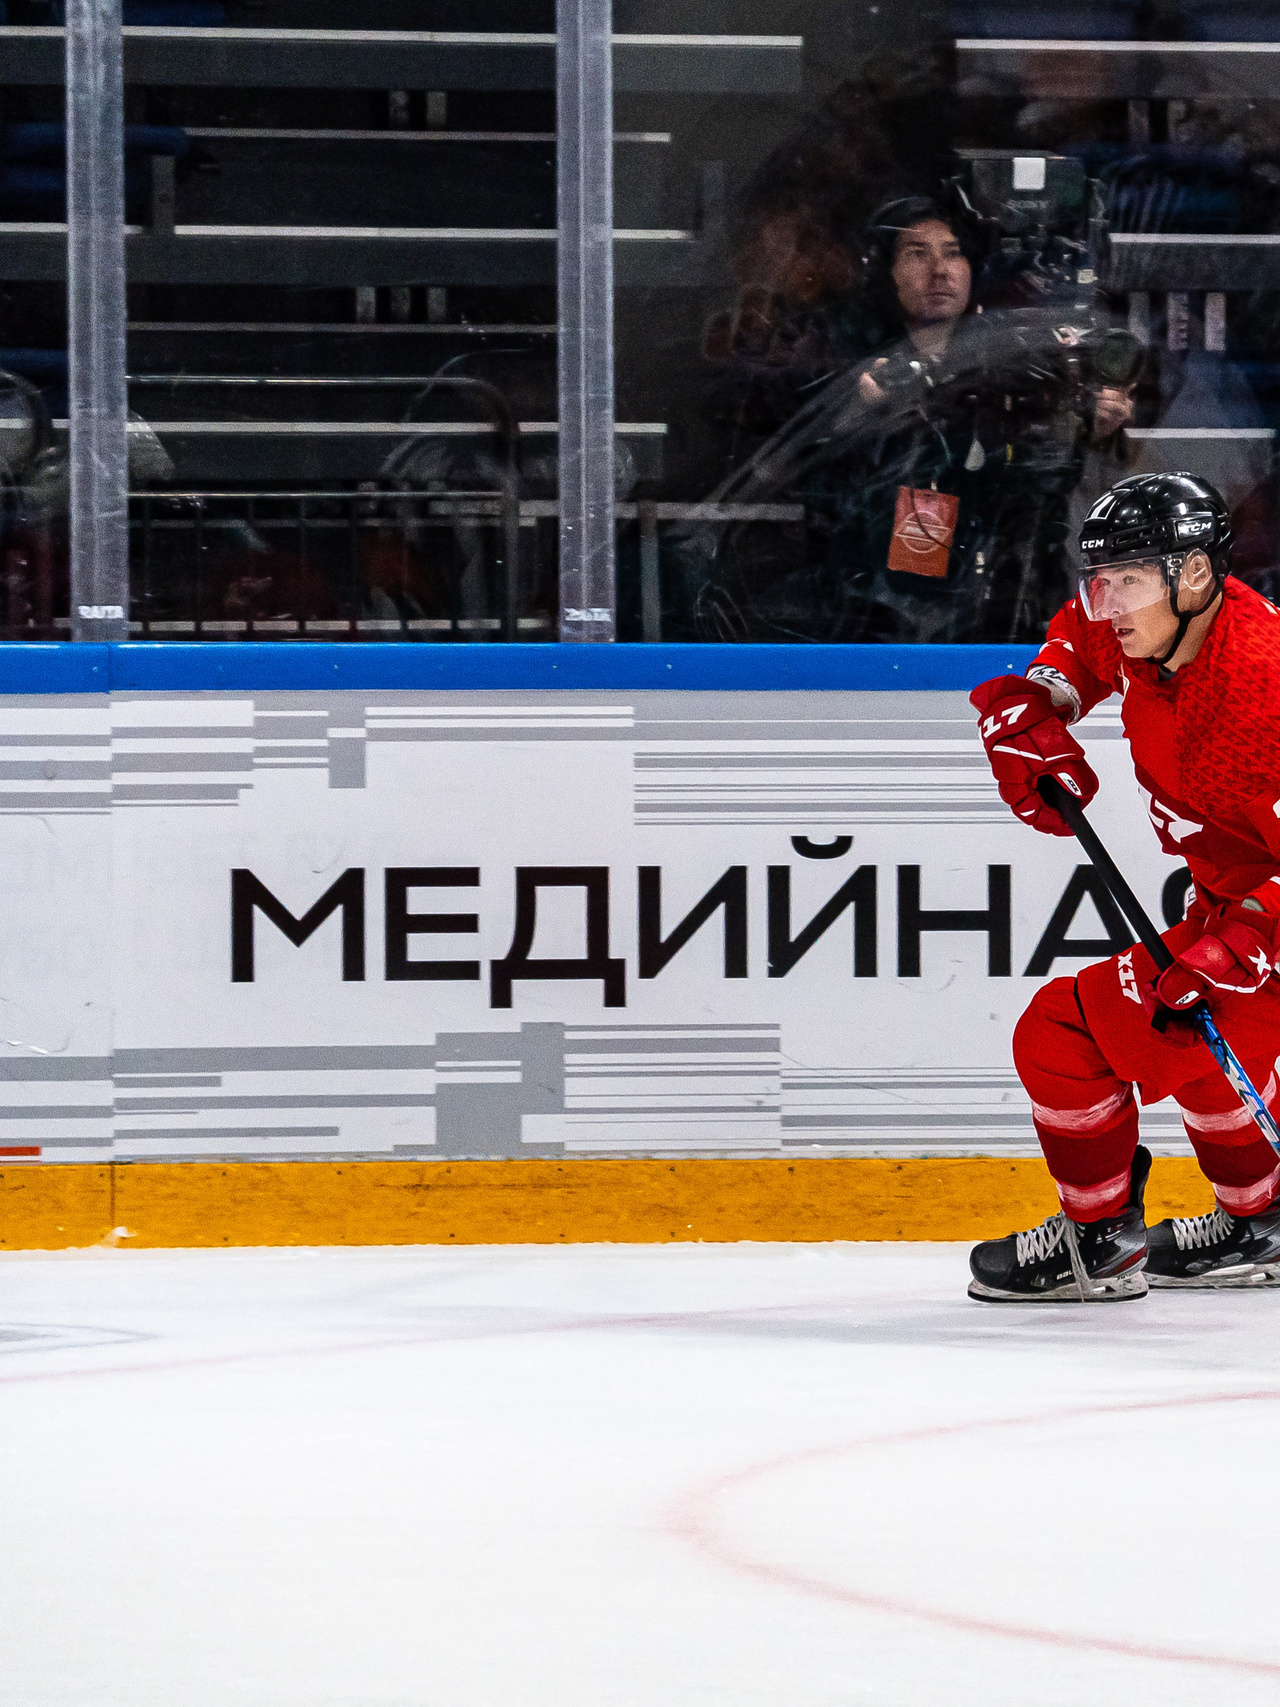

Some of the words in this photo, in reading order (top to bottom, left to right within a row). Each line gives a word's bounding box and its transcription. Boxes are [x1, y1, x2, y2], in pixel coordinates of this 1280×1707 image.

[1081, 538, 1105, 549] CCM
[982, 703, 1028, 739] 17
[230, 835, 1194, 1009] МЕДИЙНА
[1117, 951, 1143, 1005] X17
